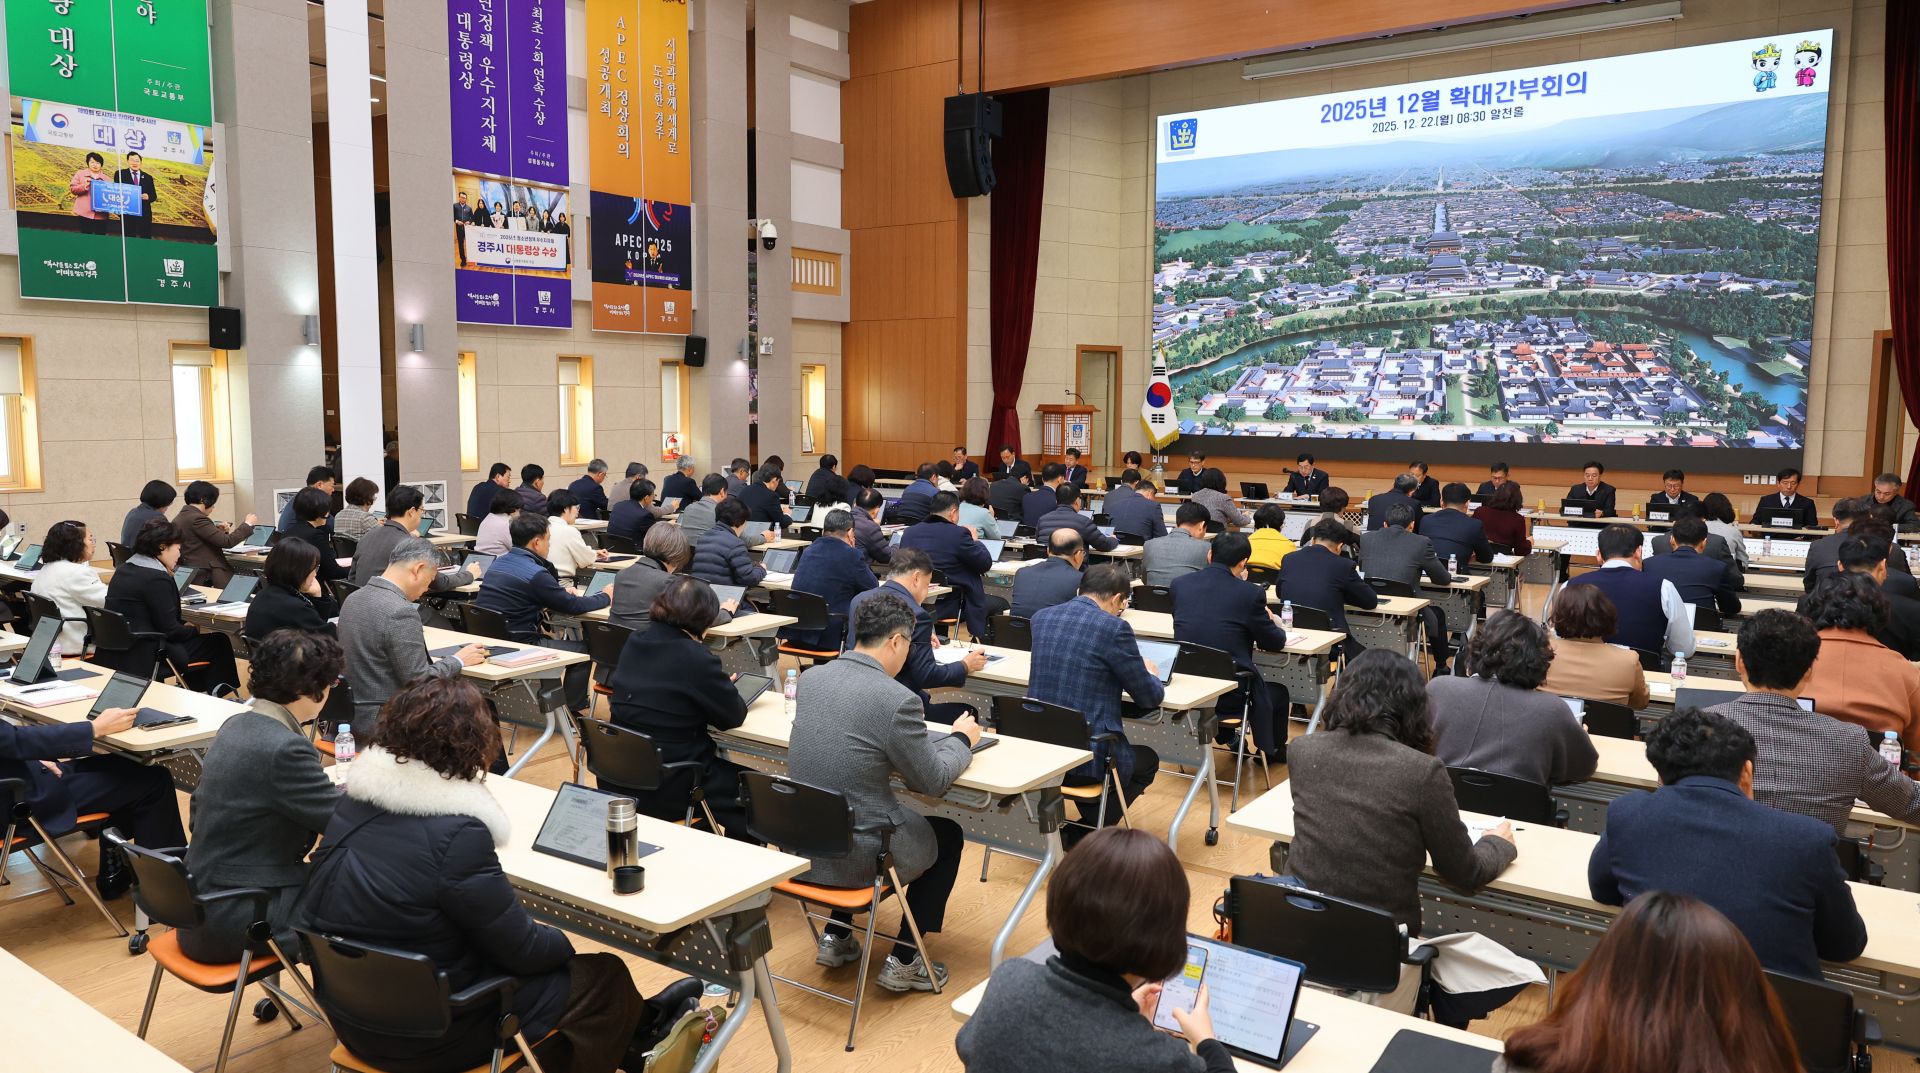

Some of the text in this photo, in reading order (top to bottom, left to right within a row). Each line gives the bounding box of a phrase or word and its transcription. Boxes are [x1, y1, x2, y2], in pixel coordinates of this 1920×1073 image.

[136, 0, 157, 25] 야
[531, 6, 544, 35] 최초
[47, 26, 78, 78] 대상
[456, 12, 474, 90] 대통령상
[532, 38, 544, 67] 2회
[533, 67, 545, 96] 연속
[598, 47, 611, 118] 성공개최
[615, 15, 629, 160] APEC 정상회의
[665, 37, 679, 154] 시민과 함께 세계로
[479, 56, 496, 154] 우수지자체
[533, 97, 546, 126] 수상
[653, 64, 665, 141] 도약한 경주
[1320, 71, 1588, 124] 2025년 12월 확대간부회의
[1372, 120, 1399, 133] 2025.
[1403, 118, 1418, 130] 12.
[1456, 110, 1486, 124] 08:30
[1490, 106, 1524, 121] 알천홀
[477, 240, 558, 258] 경주시 대통령상 수상
[615, 233, 672, 252] APEC 025
[157, 278, 191, 289] 경주시
